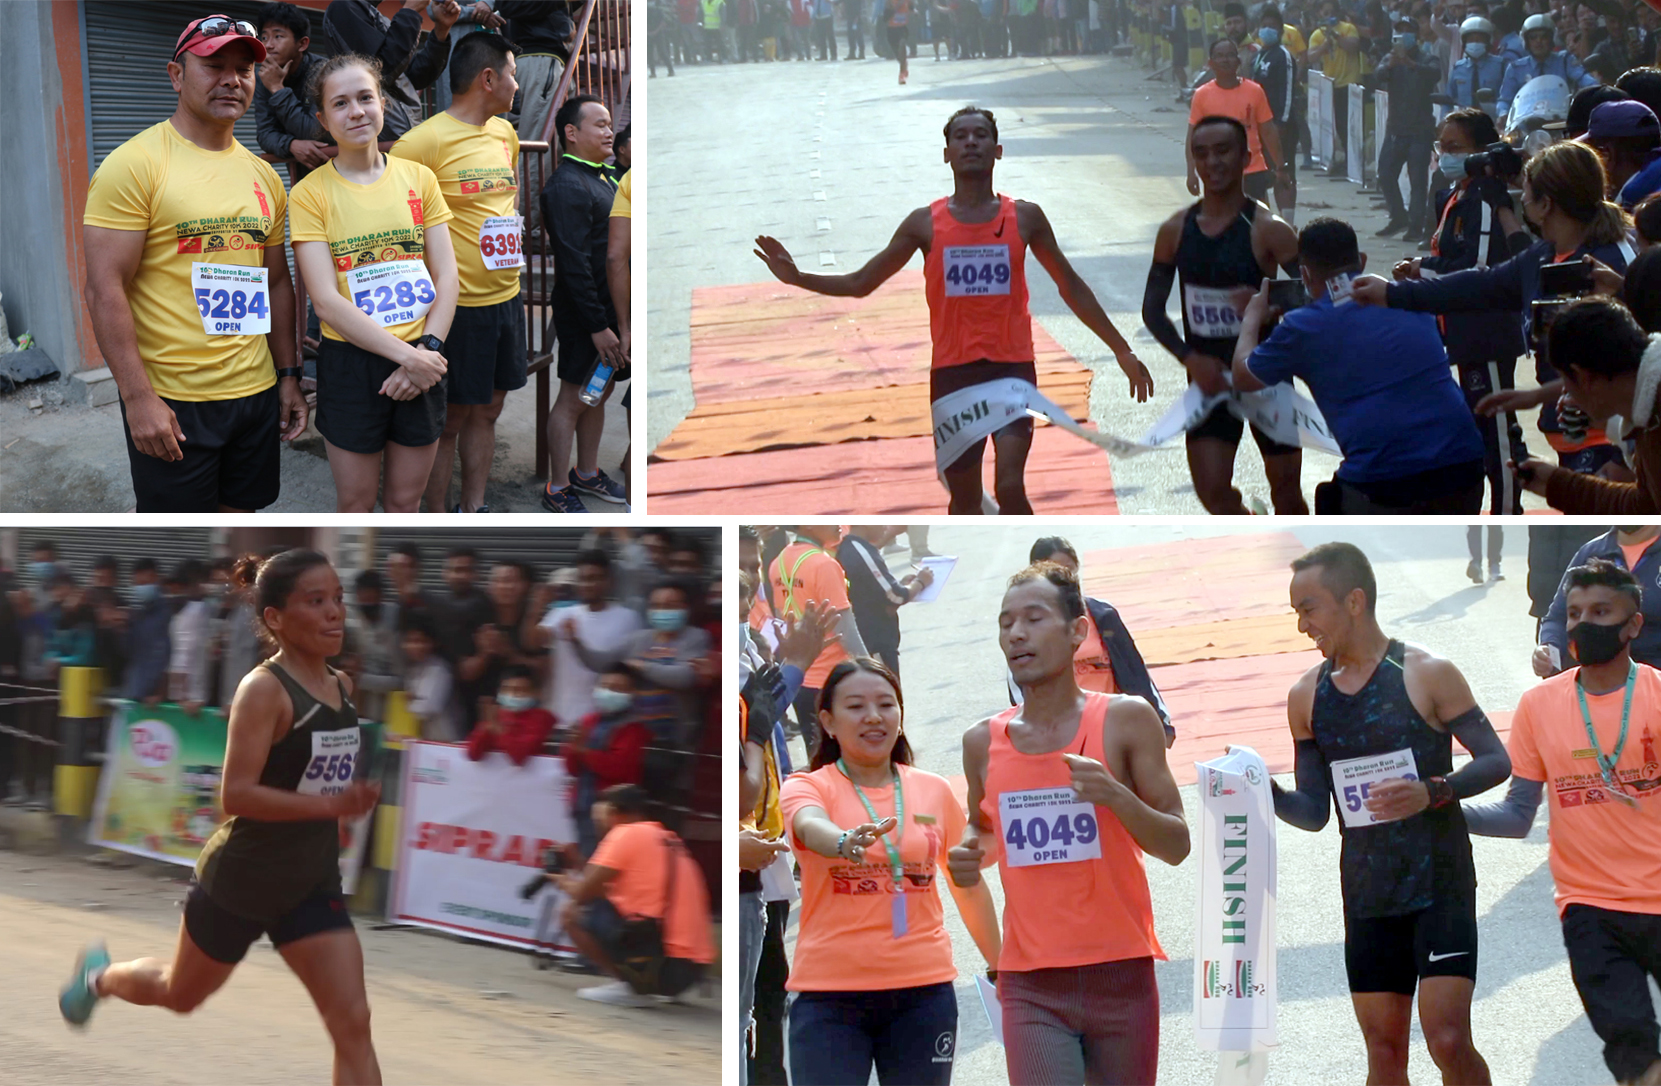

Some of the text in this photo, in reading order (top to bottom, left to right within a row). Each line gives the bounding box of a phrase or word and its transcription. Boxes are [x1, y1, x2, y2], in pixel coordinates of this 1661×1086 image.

[200, 217, 238, 226] DHARAN
[177, 227, 201, 235] NEWA
[347, 230, 390, 244] DHARAN
[391, 228, 411, 237] RUN
[331, 246, 349, 254] NEWA
[350, 239, 380, 250] CHARITY
[213, 267, 237, 275] Dharan
[369, 265, 395, 275] Dharan
[946, 263, 1010, 286] 4049
[371, 273, 390, 281] CHARITY
[964, 286, 989, 294] OPEN
[194, 288, 269, 319] 5284
[354, 278, 436, 316] 5283
[384, 310, 414, 323] OPEN
[1192, 305, 1243, 326] 556
[215, 322, 241, 332] OPEN
[1292, 407, 1334, 440] FIN
[305, 752, 357, 782] 556
[1354, 763, 1379, 772] Dharan
[1573, 772, 1601, 781] DHAR
[1576, 778, 1602, 786] CHARIT
[1023, 793, 1052, 802] Dharan
[1343, 773, 1418, 813] 55
[1006, 813, 1097, 850] 4049
[1033, 849, 1068, 862] OPEN
[1222, 813, 1248, 945] FINISH
